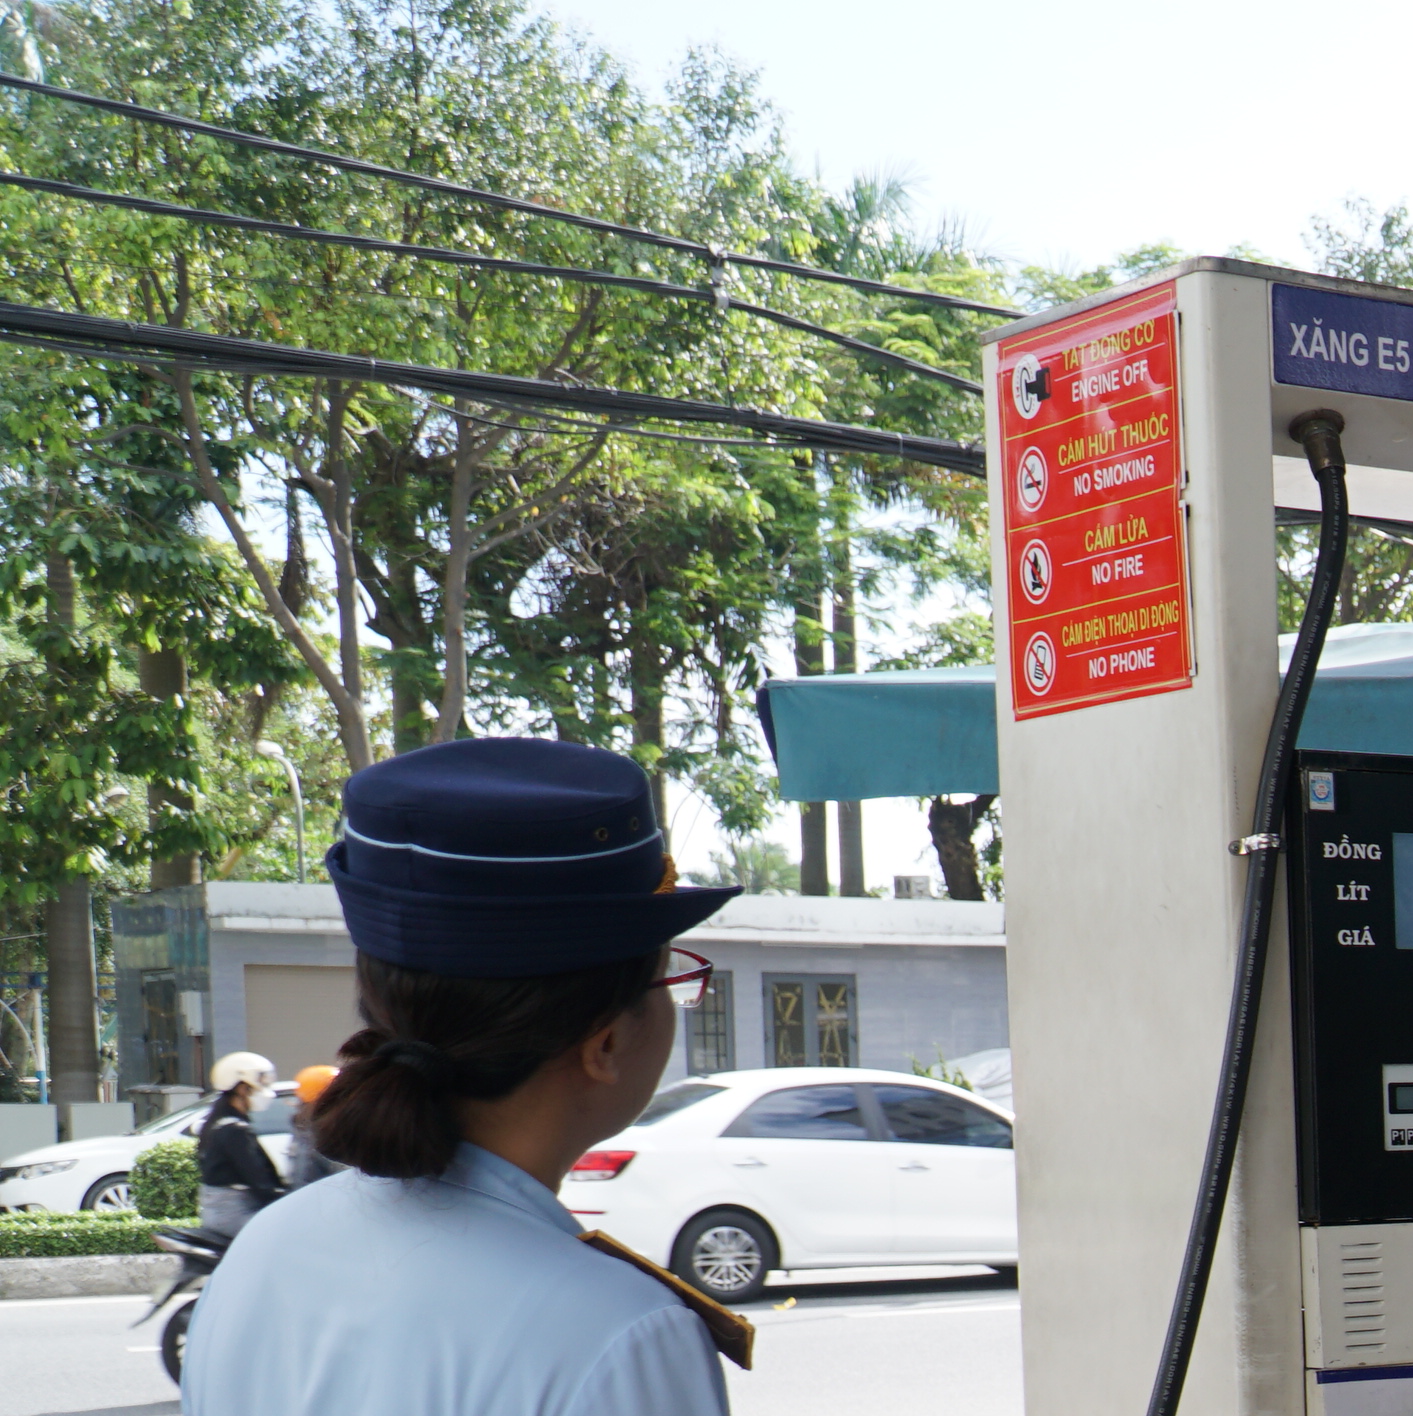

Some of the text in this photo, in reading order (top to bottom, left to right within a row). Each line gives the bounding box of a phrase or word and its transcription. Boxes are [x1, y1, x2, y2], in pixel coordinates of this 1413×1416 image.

[1289, 316, 1369, 367] XĂNG
[1378, 337, 1410, 373] E5
[1071, 359, 1149, 404] ENGINE OFF
[1088, 425, 1118, 458] HÚT
[1120, 413, 1170, 449] THUỐC
[1074, 454, 1155, 497] NO SMOKING
[1117, 515, 1149, 548] LỬA
[1092, 553, 1144, 586] NO FIRE
[1140, 611, 1150, 634] DI
[1088, 647, 1155, 680] NO PHONE
[1323, 833, 1382, 860] ĐỒNG
[1336, 880, 1371, 901] LÍT
[1337, 925, 1376, 946] GIÁ
[1392, 1131, 1405, 1141] P1
